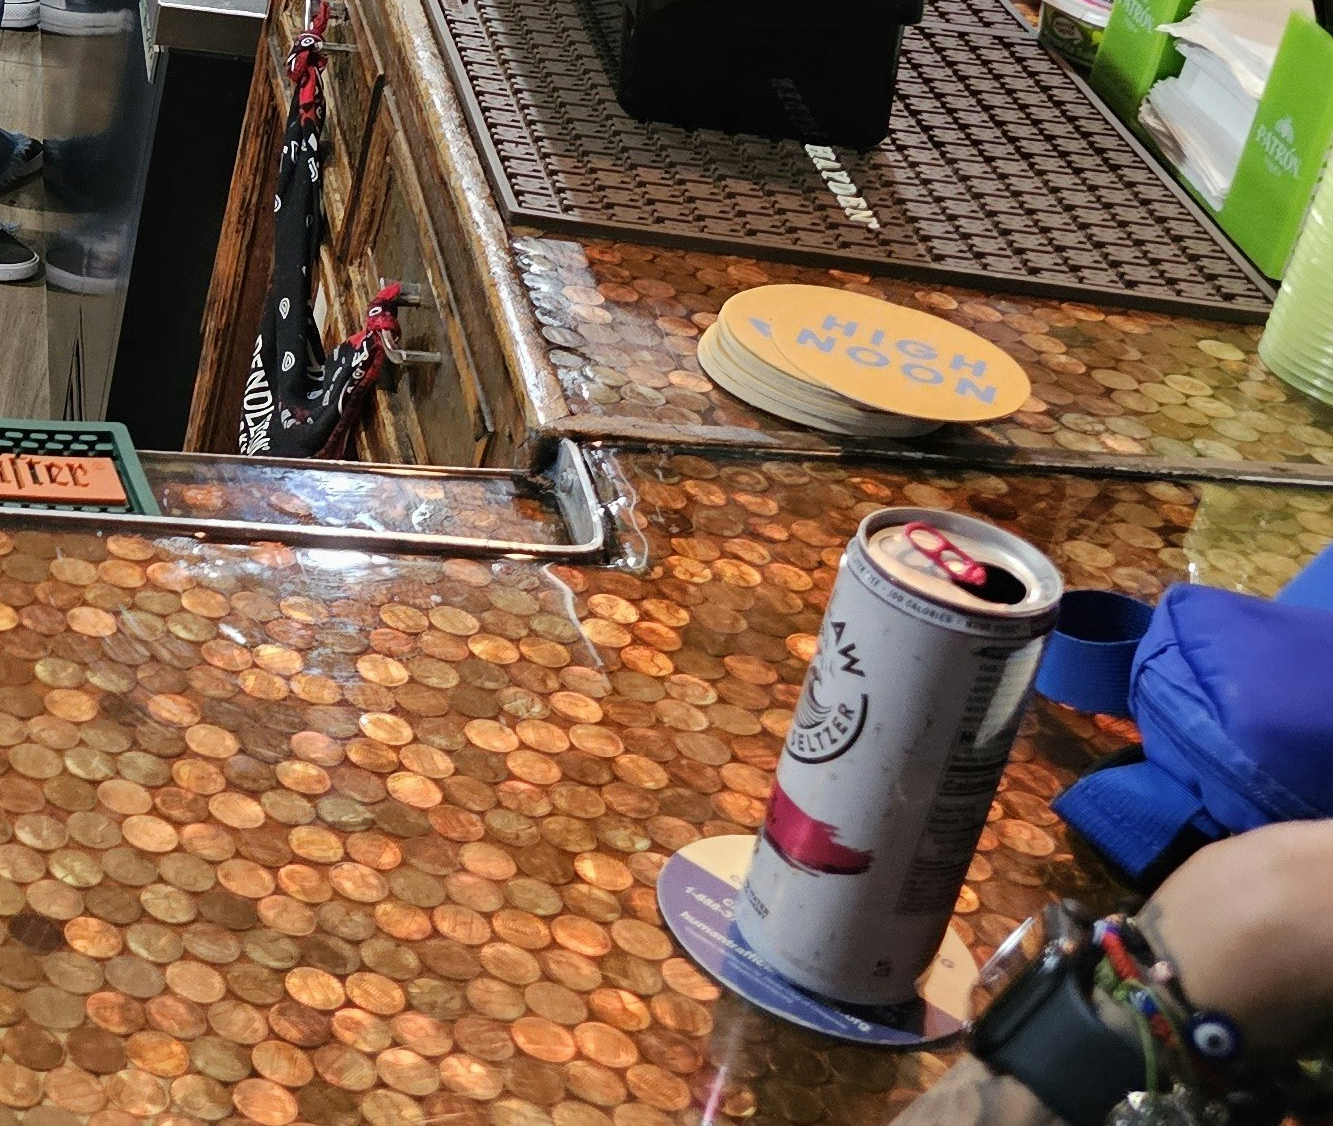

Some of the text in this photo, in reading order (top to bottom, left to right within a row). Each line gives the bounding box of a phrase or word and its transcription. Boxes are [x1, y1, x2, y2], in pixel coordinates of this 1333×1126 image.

[795, 328, 998, 405] NOON
[821, 314, 988, 378] HIGH
[905, 598, 953, 624] CALORIES
